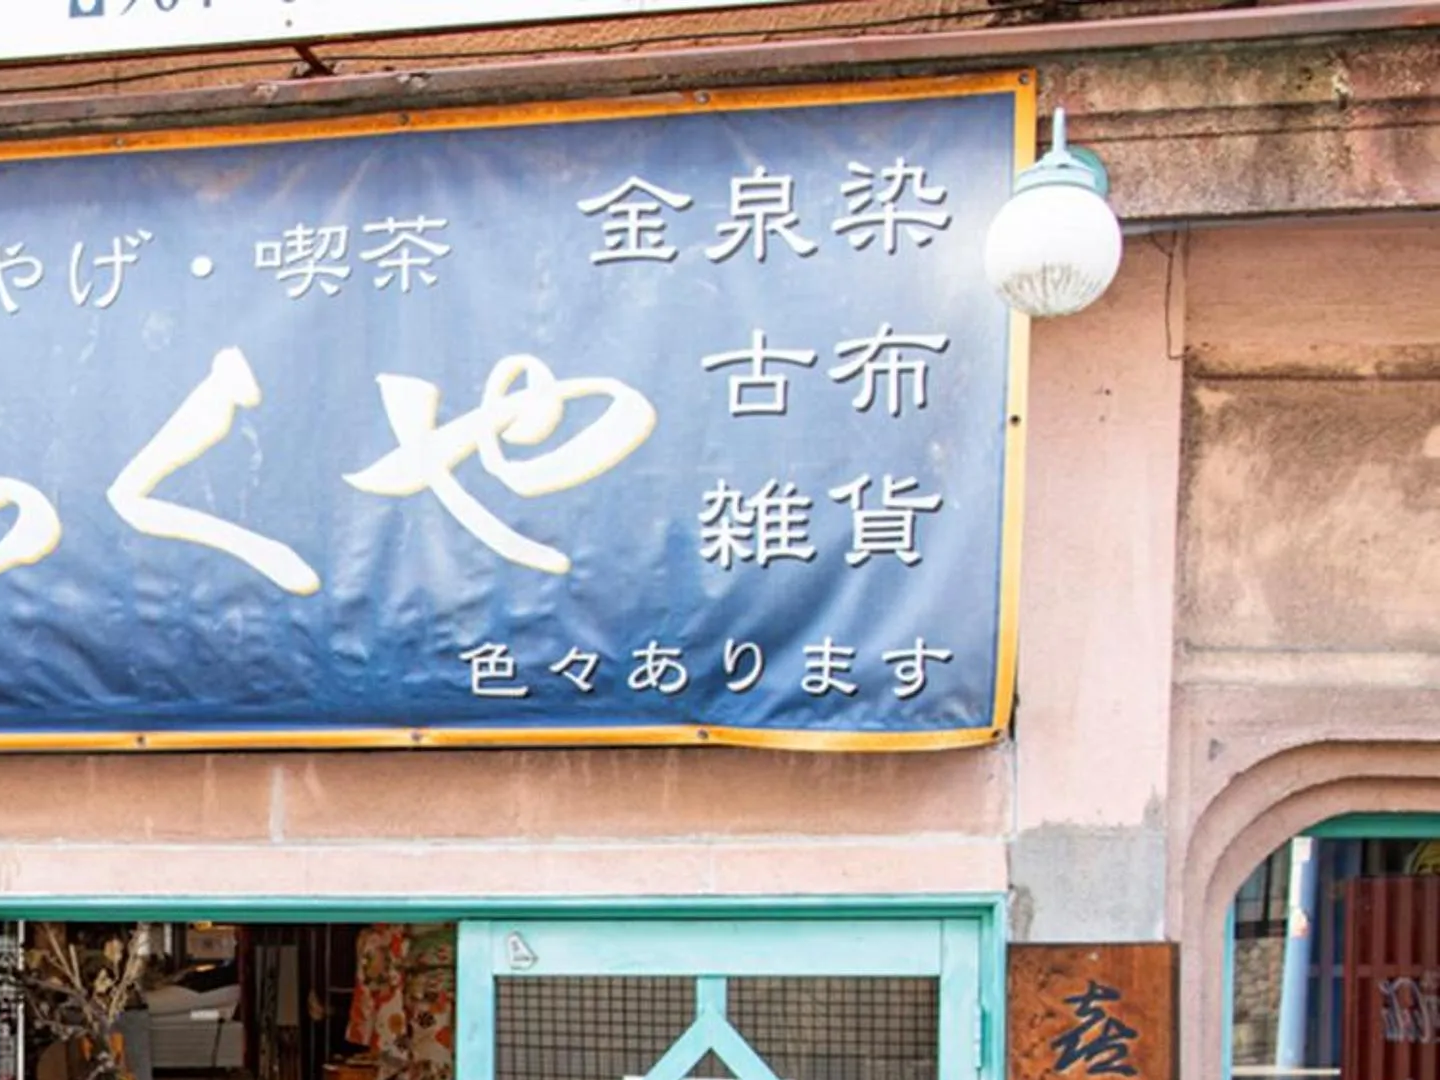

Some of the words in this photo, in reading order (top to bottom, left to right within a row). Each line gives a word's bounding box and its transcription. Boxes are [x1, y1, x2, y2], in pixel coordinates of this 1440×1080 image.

[578, 157, 951, 265] 金泉染
[701, 322, 948, 416] 古布
[698, 474, 942, 568] 雑貨
[459, 635, 953, 698] 色々あります
